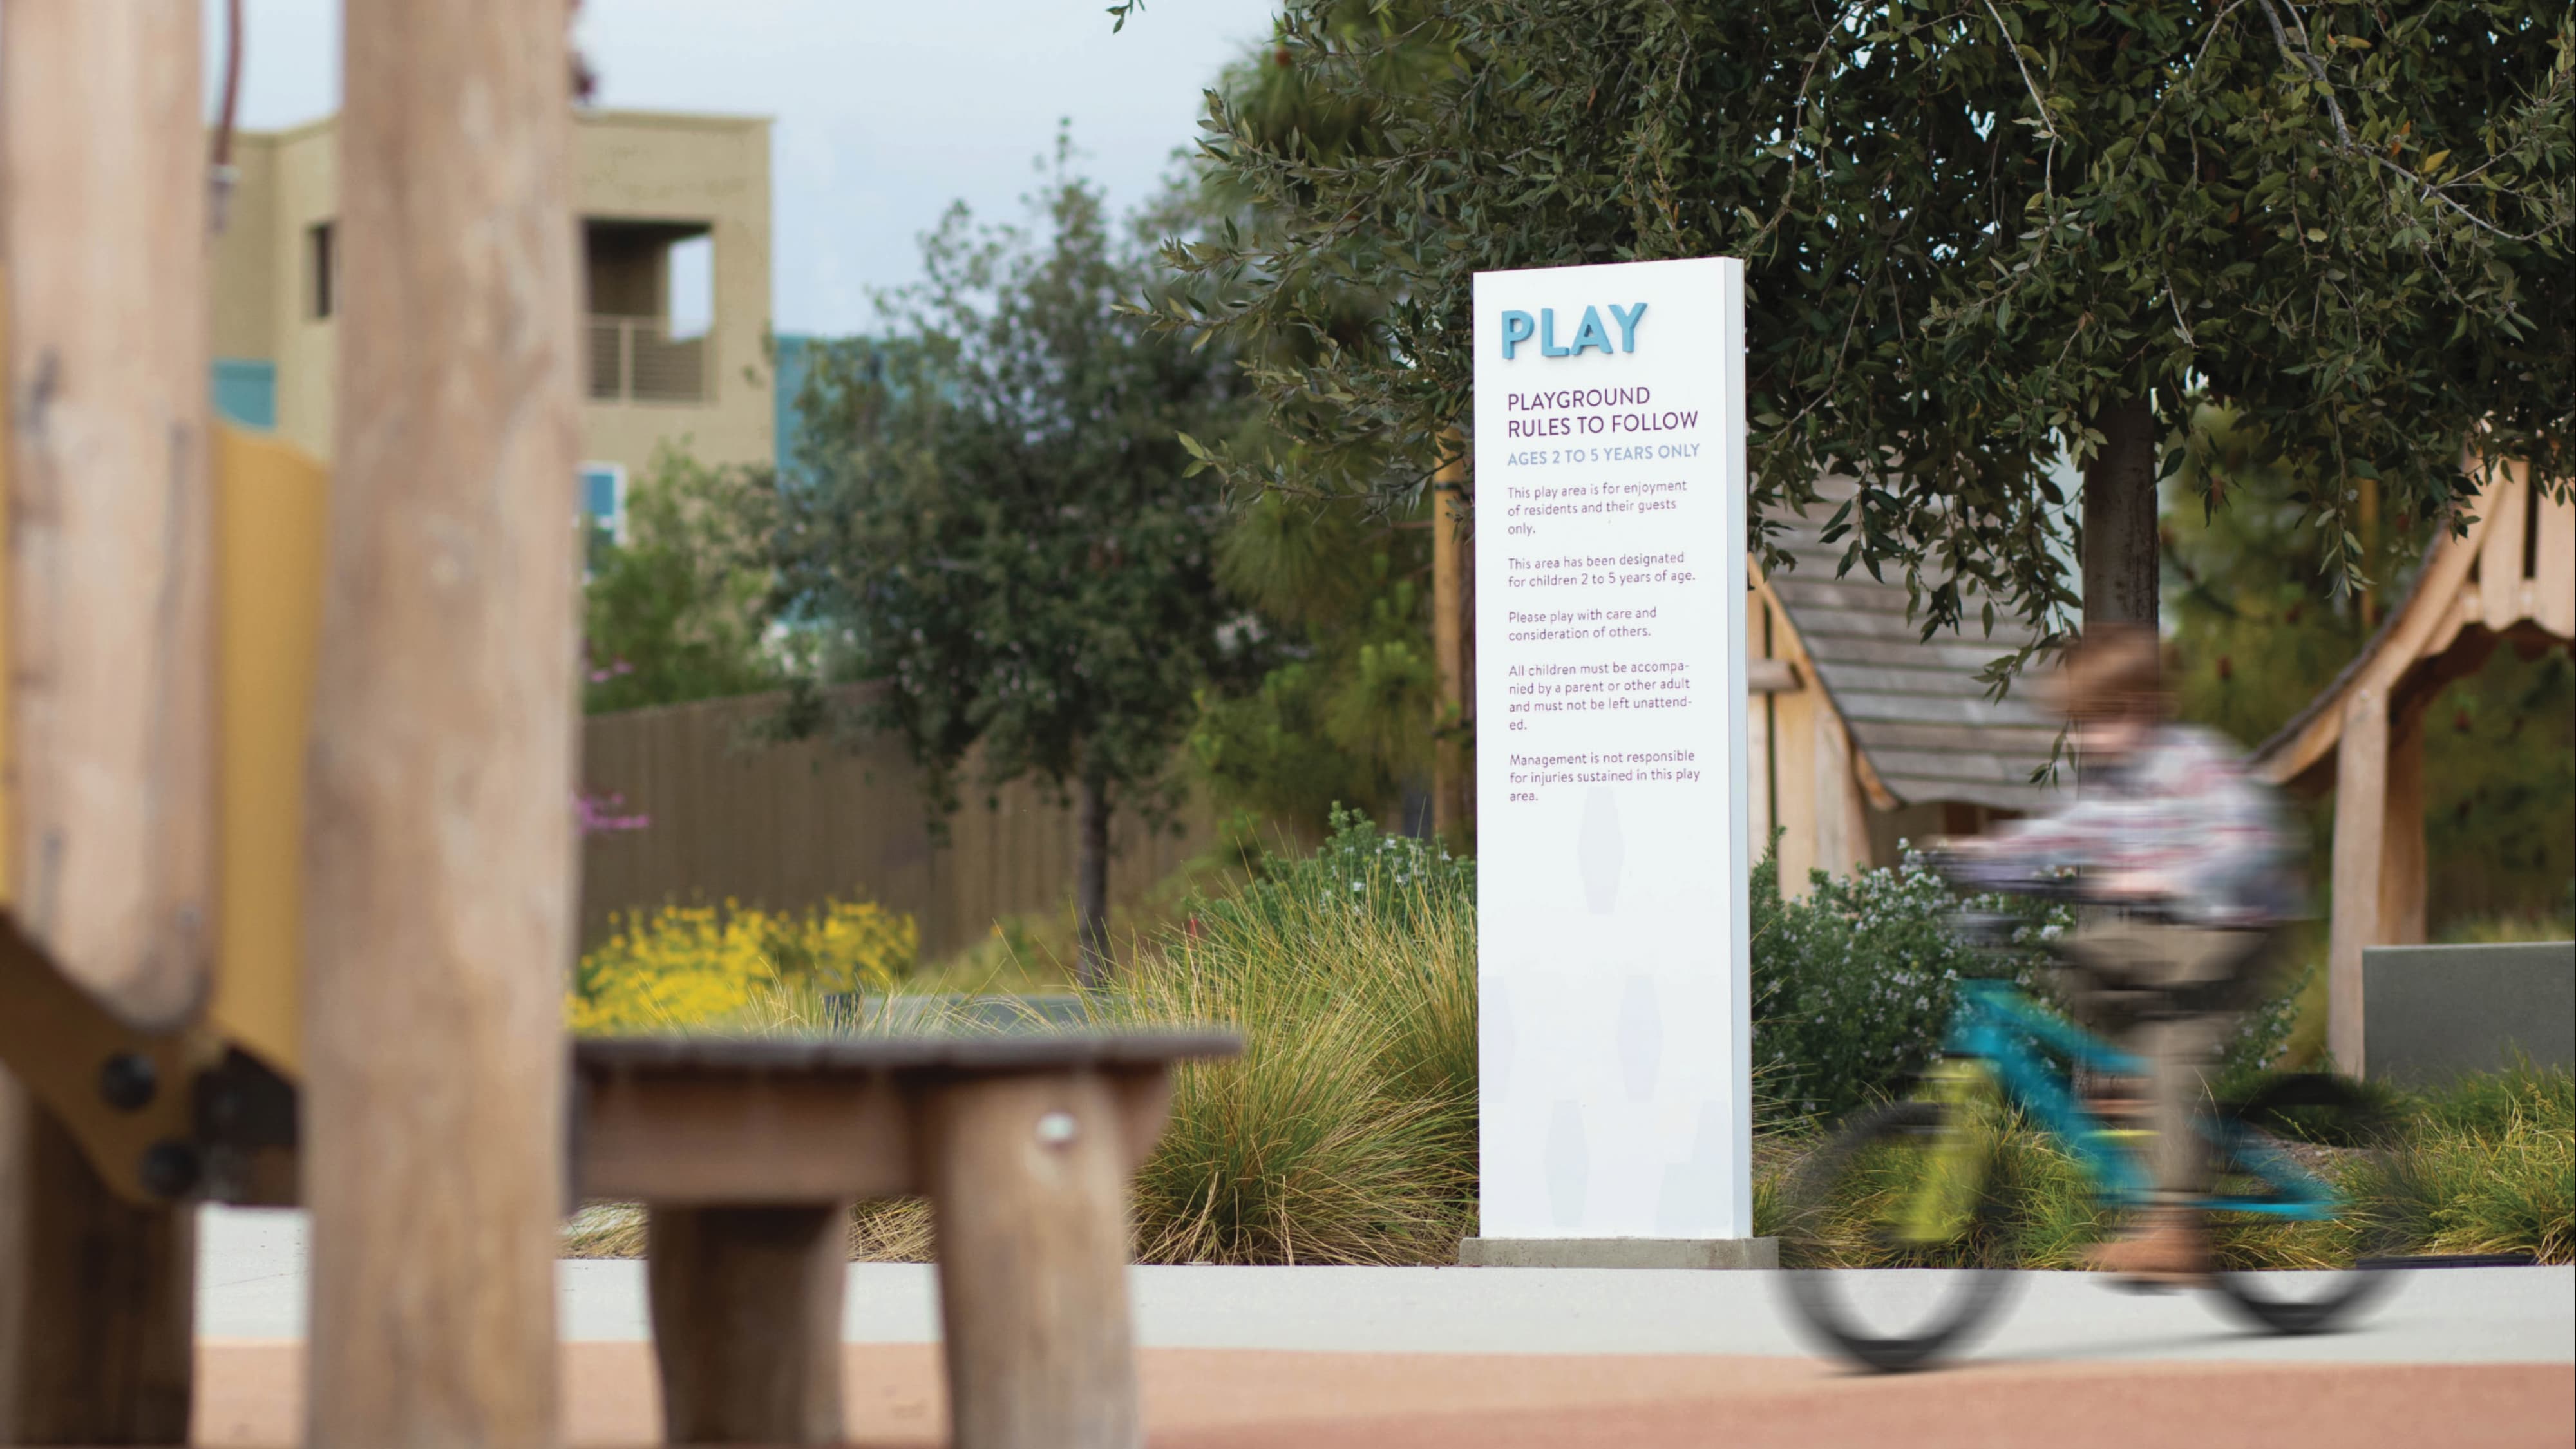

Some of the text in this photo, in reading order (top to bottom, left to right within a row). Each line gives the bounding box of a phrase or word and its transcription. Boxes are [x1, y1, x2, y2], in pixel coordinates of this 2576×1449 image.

[1502, 303, 1647, 360] PLAY
[1508, 387, 1650, 412] PLAYGROUND
[1509, 410, 1698, 438] RULES TO FOLLOW
[1508, 443, 1700, 466] AGES 2 TO 5 YEARS ONLY
[1508, 480, 1687, 500] This play area is for enjoyment
[1508, 500, 1676, 516] of residents and their guests
[1508, 522, 1535, 536] only.
[1508, 551, 1684, 569] This area has been designated
[1508, 569, 1695, 587] for children 2 to 5 years of age.
[1509, 607, 1656, 624] Please play with care and
[1509, 626, 1651, 641] consideration of others.
[1509, 662, 1689, 676] All children must be accompa-
[1510, 683, 1534, 694] nied
[1538, 683, 1551, 696] by
[1566, 681, 1604, 696] parent
[1608, 683, 1620, 691] or
[1624, 679, 1656, 690] other
[1660, 678, 1690, 689] adult
[1510, 696, 1691, 712] and must not be left unattend-
[1510, 719, 1527, 730] ed.
[1510, 750, 1694, 768] Management is not responsible
[1510, 768, 1700, 786] for injuries sustained in this play
[1510, 793, 1538, 802] area.
